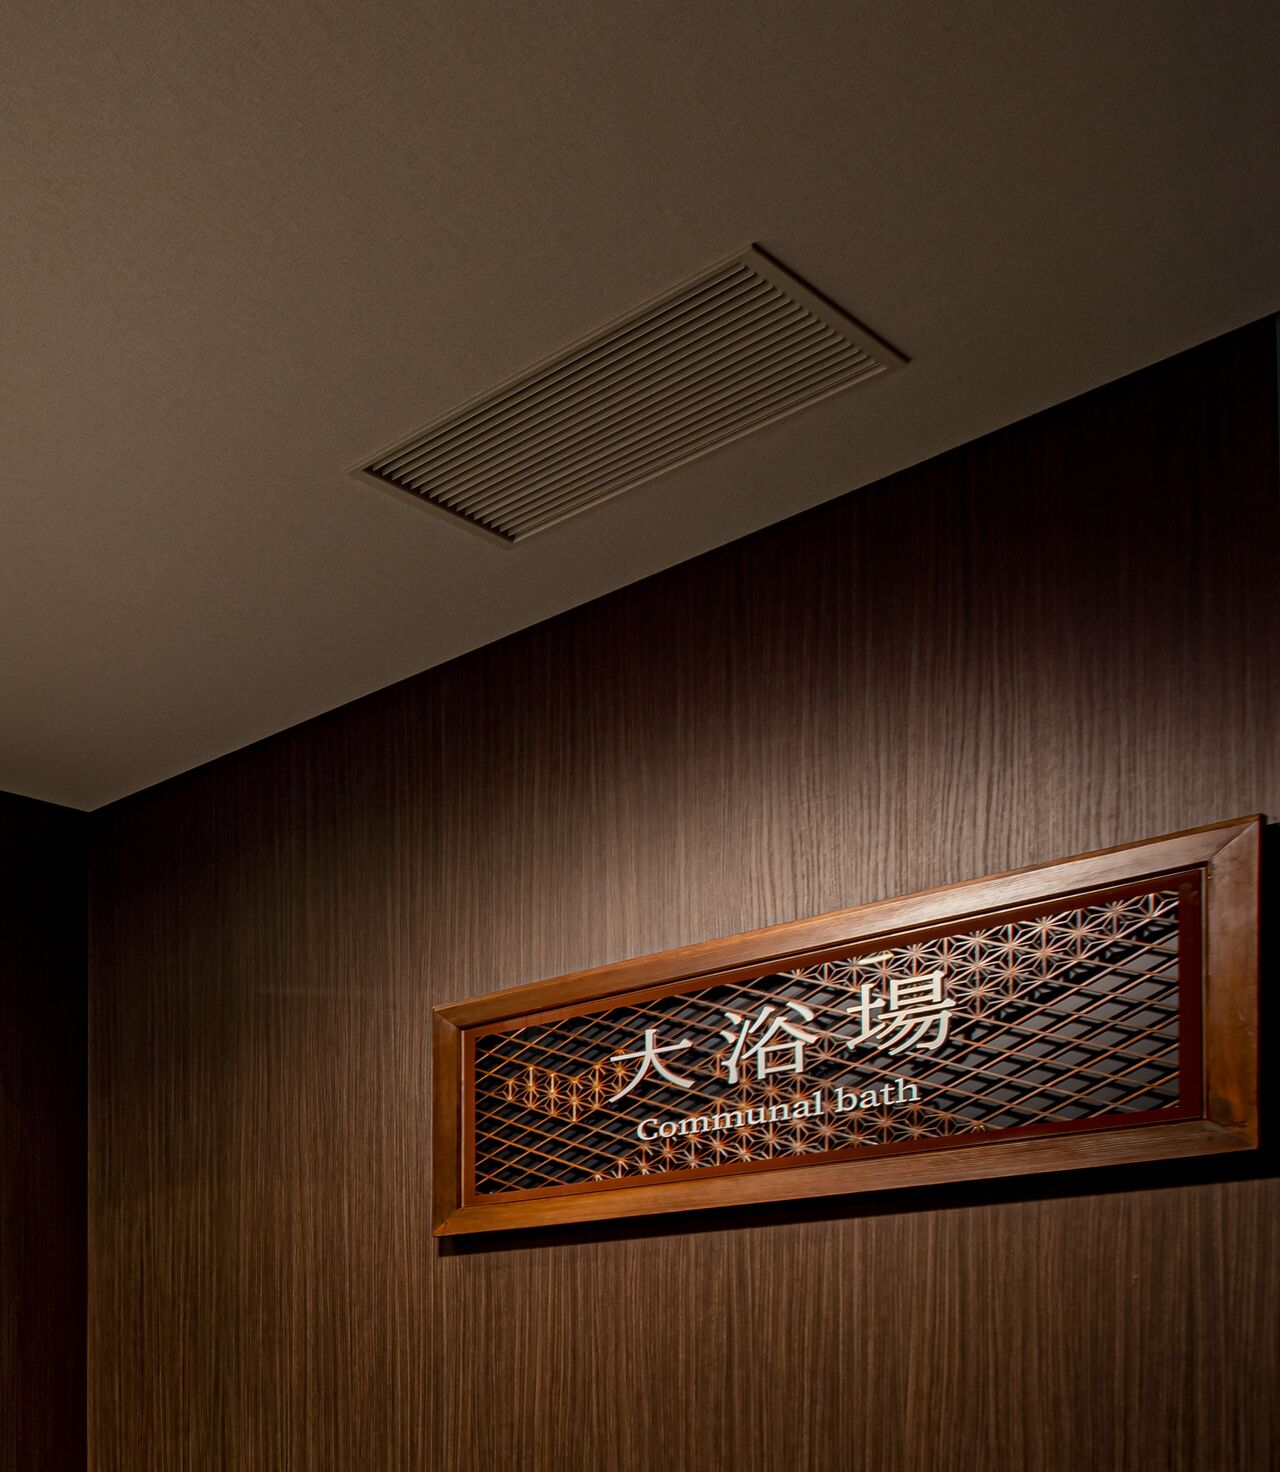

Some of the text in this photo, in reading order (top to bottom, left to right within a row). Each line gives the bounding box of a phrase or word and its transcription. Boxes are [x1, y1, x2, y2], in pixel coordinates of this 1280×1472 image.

[609, 970, 956, 1103] 大浴場
[637, 1077, 921, 1141] Communal bath
